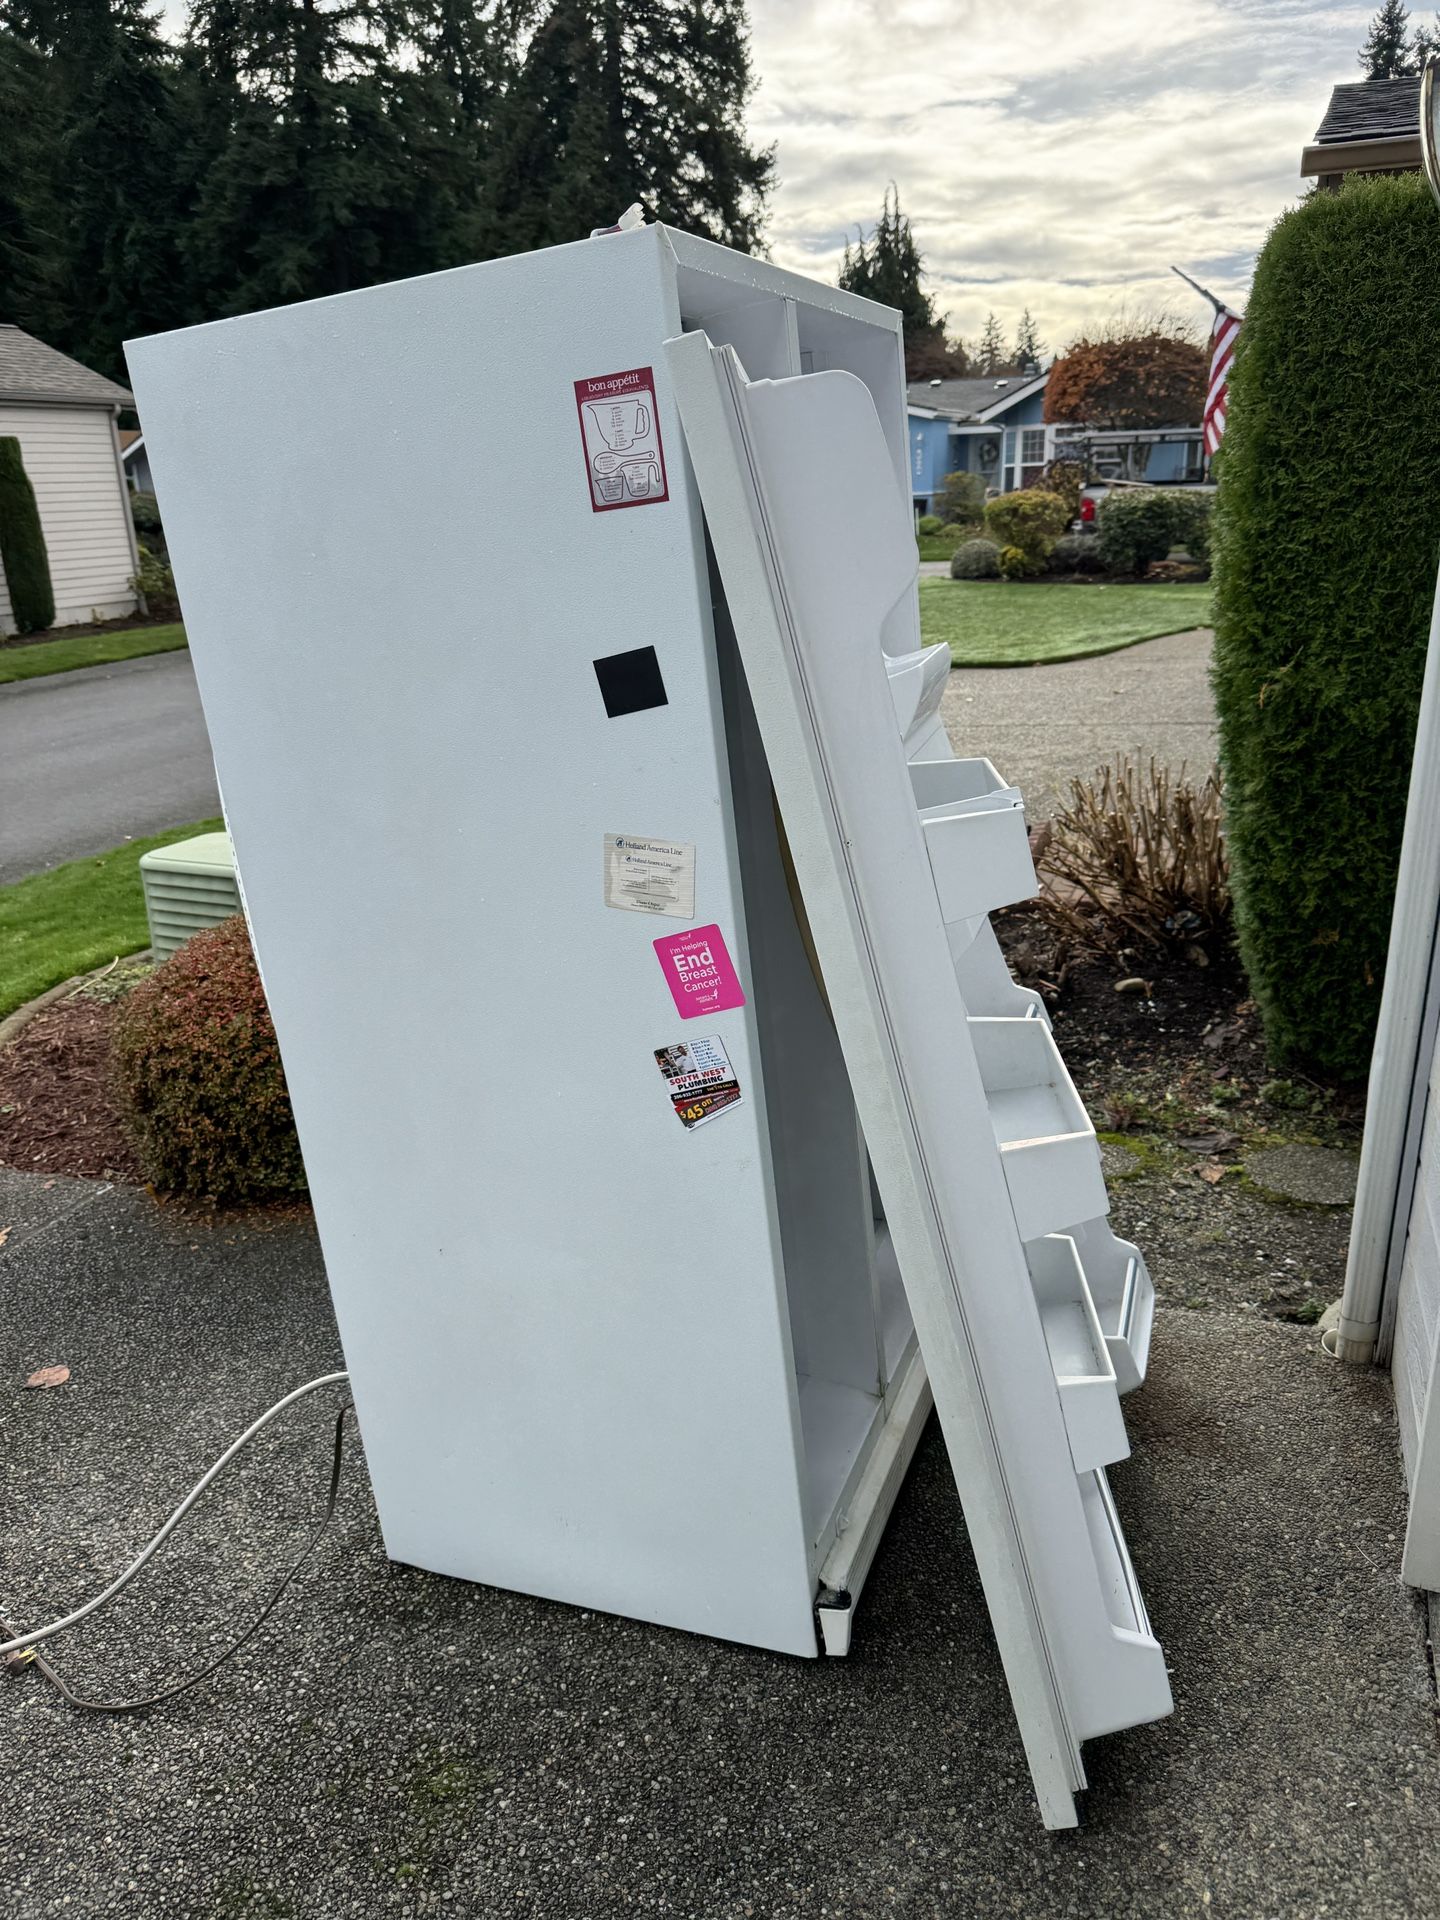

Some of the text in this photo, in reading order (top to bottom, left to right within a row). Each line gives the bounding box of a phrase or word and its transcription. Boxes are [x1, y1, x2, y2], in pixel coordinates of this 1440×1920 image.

[587, 373, 640, 392] bon appétit
[625, 841, 683, 856] Holland America Line
[669, 940, 708, 955] I'm Helping
[672, 946, 714, 972] End
[679, 965, 718, 983] Breast
[684, 975, 722, 993] Cancer!
[669, 1066, 726, 1086] SOUTH WEST
[677, 1075, 724, 1091] PLUMBING
[680, 1104, 704, 1120] $45
